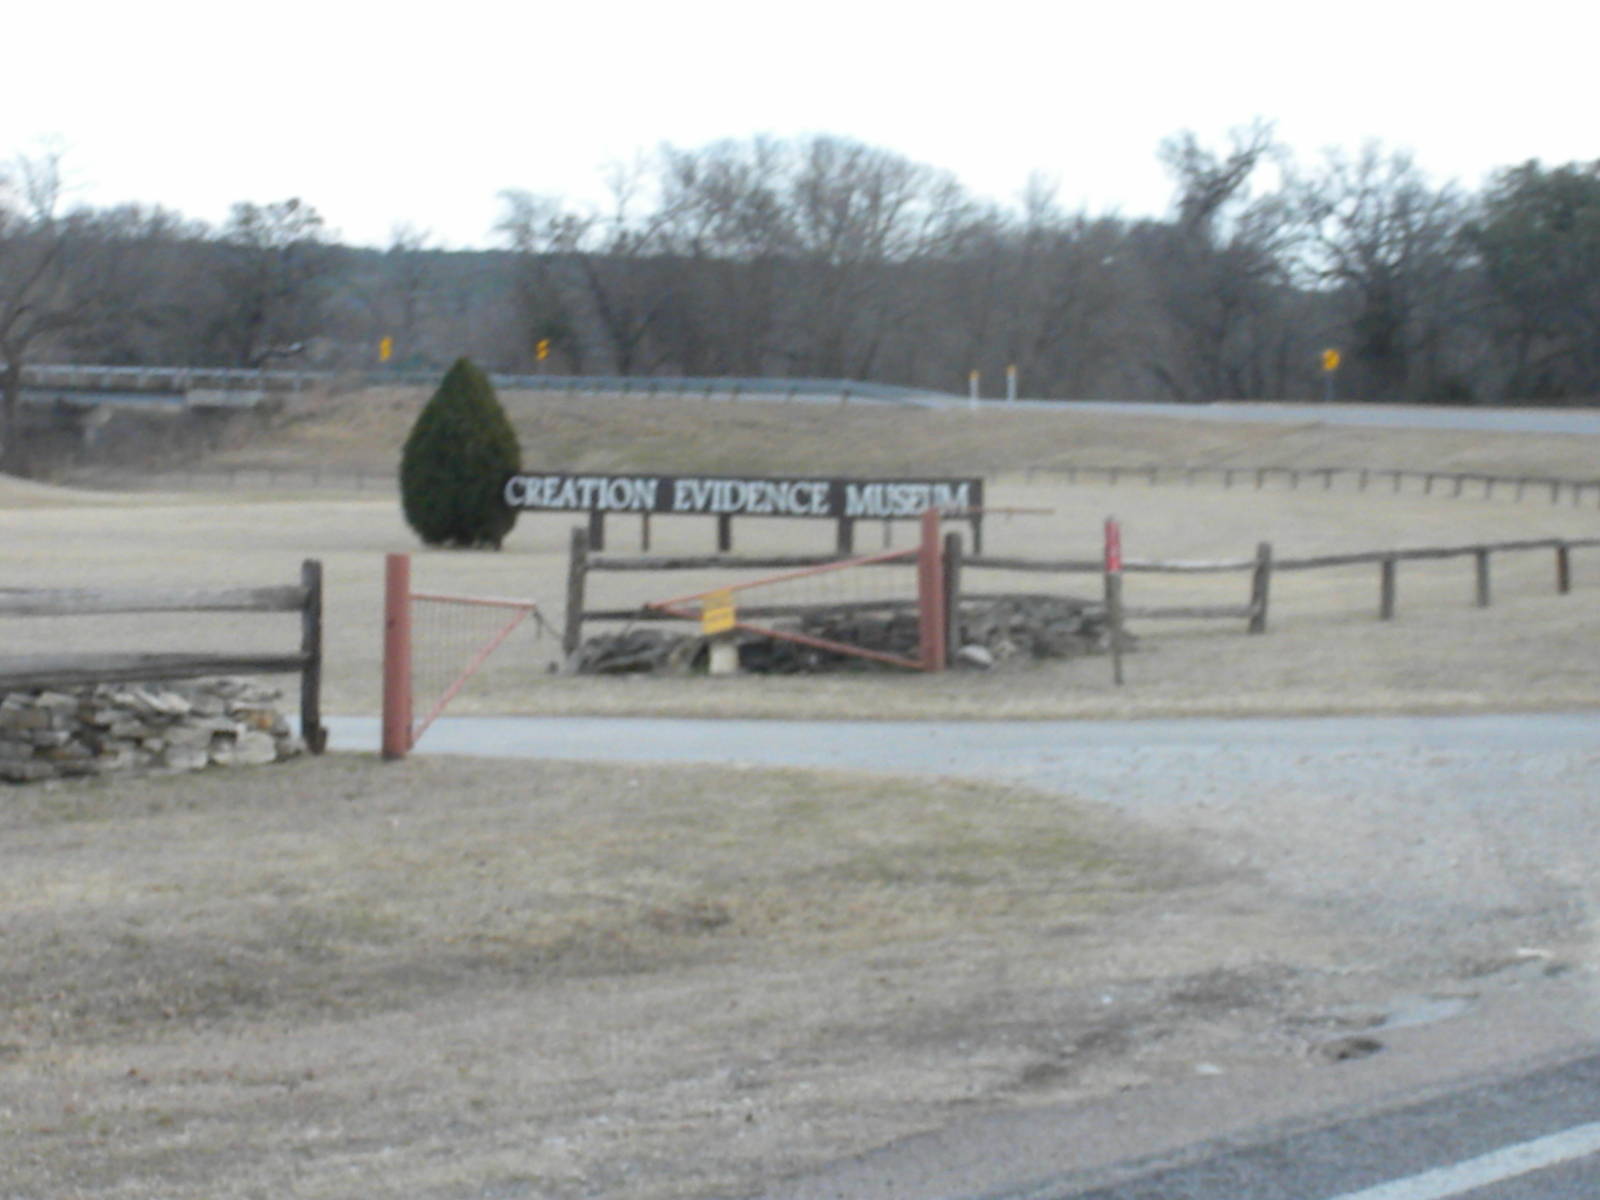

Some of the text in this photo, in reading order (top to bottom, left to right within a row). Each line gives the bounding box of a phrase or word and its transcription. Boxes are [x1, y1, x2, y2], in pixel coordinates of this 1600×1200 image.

[504, 475, 971, 516] CREATION EVIDENCE MUSEUM
